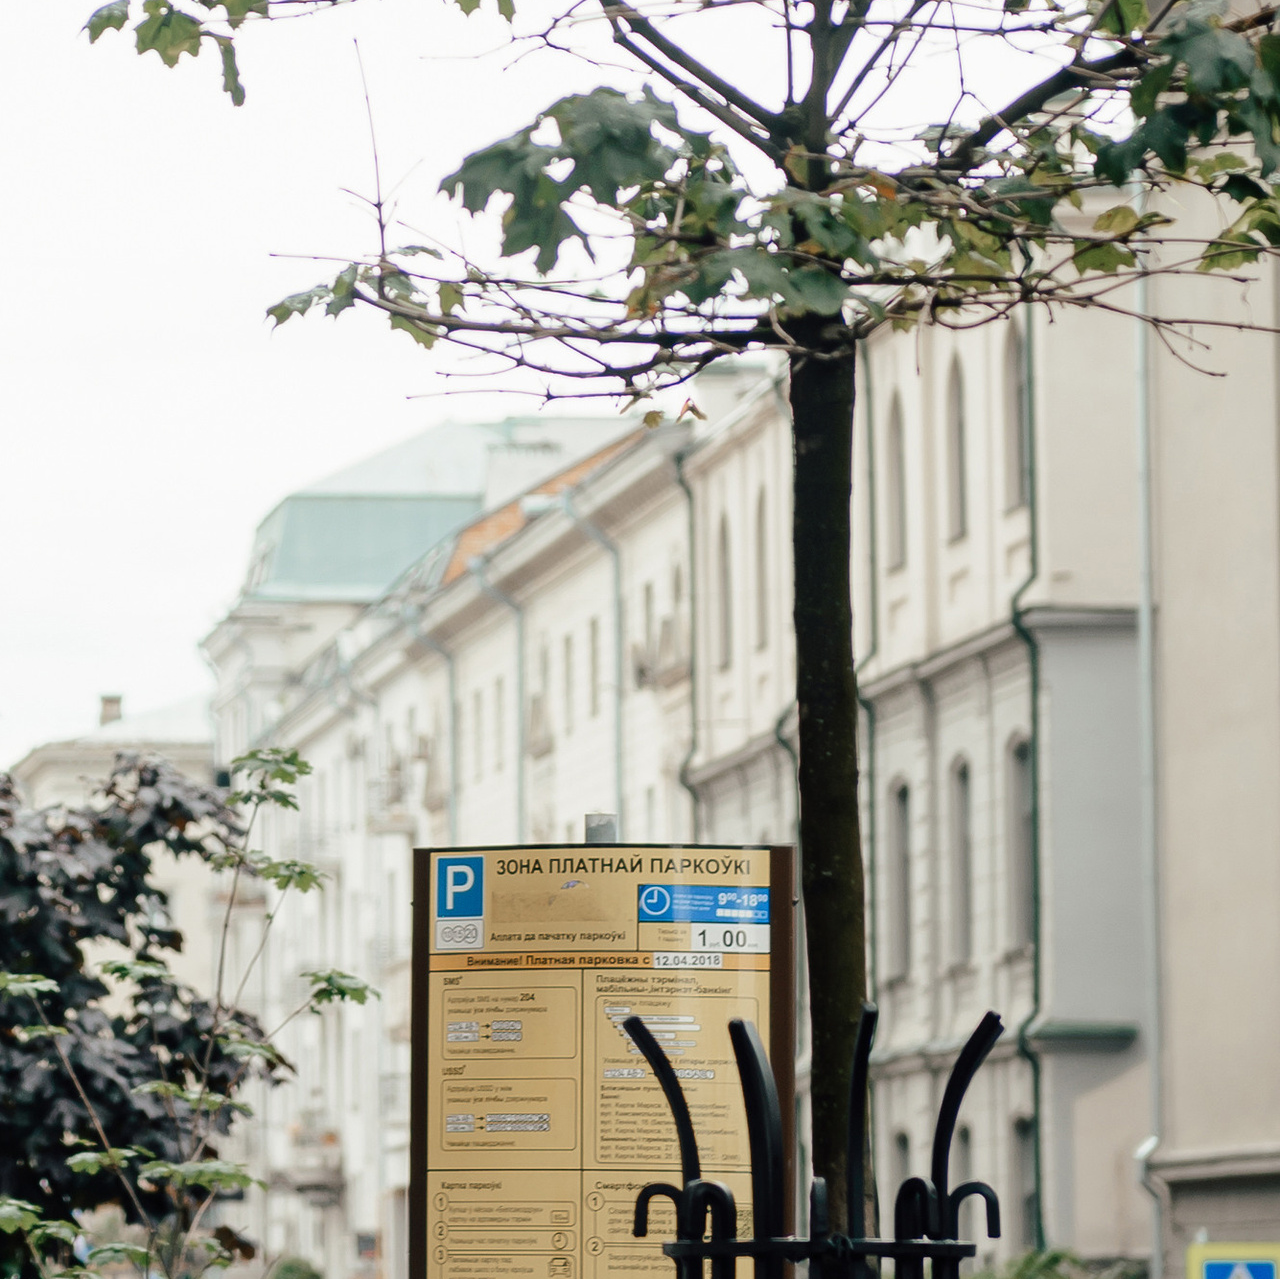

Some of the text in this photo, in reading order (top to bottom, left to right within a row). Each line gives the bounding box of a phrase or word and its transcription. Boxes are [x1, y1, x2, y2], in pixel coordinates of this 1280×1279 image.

[496, 854, 751, 875] ЗОНА ПЛАТНАЙ ПАРКОЎКІ
[446, 865, 475, 910] P
[698, 929, 707, 947] 1
[723, 930, 747, 947] 00
[467, 954, 721, 967] Внимание! Платная парковка с 12.04.2018
[592, 1241, 598, 1251] 2
